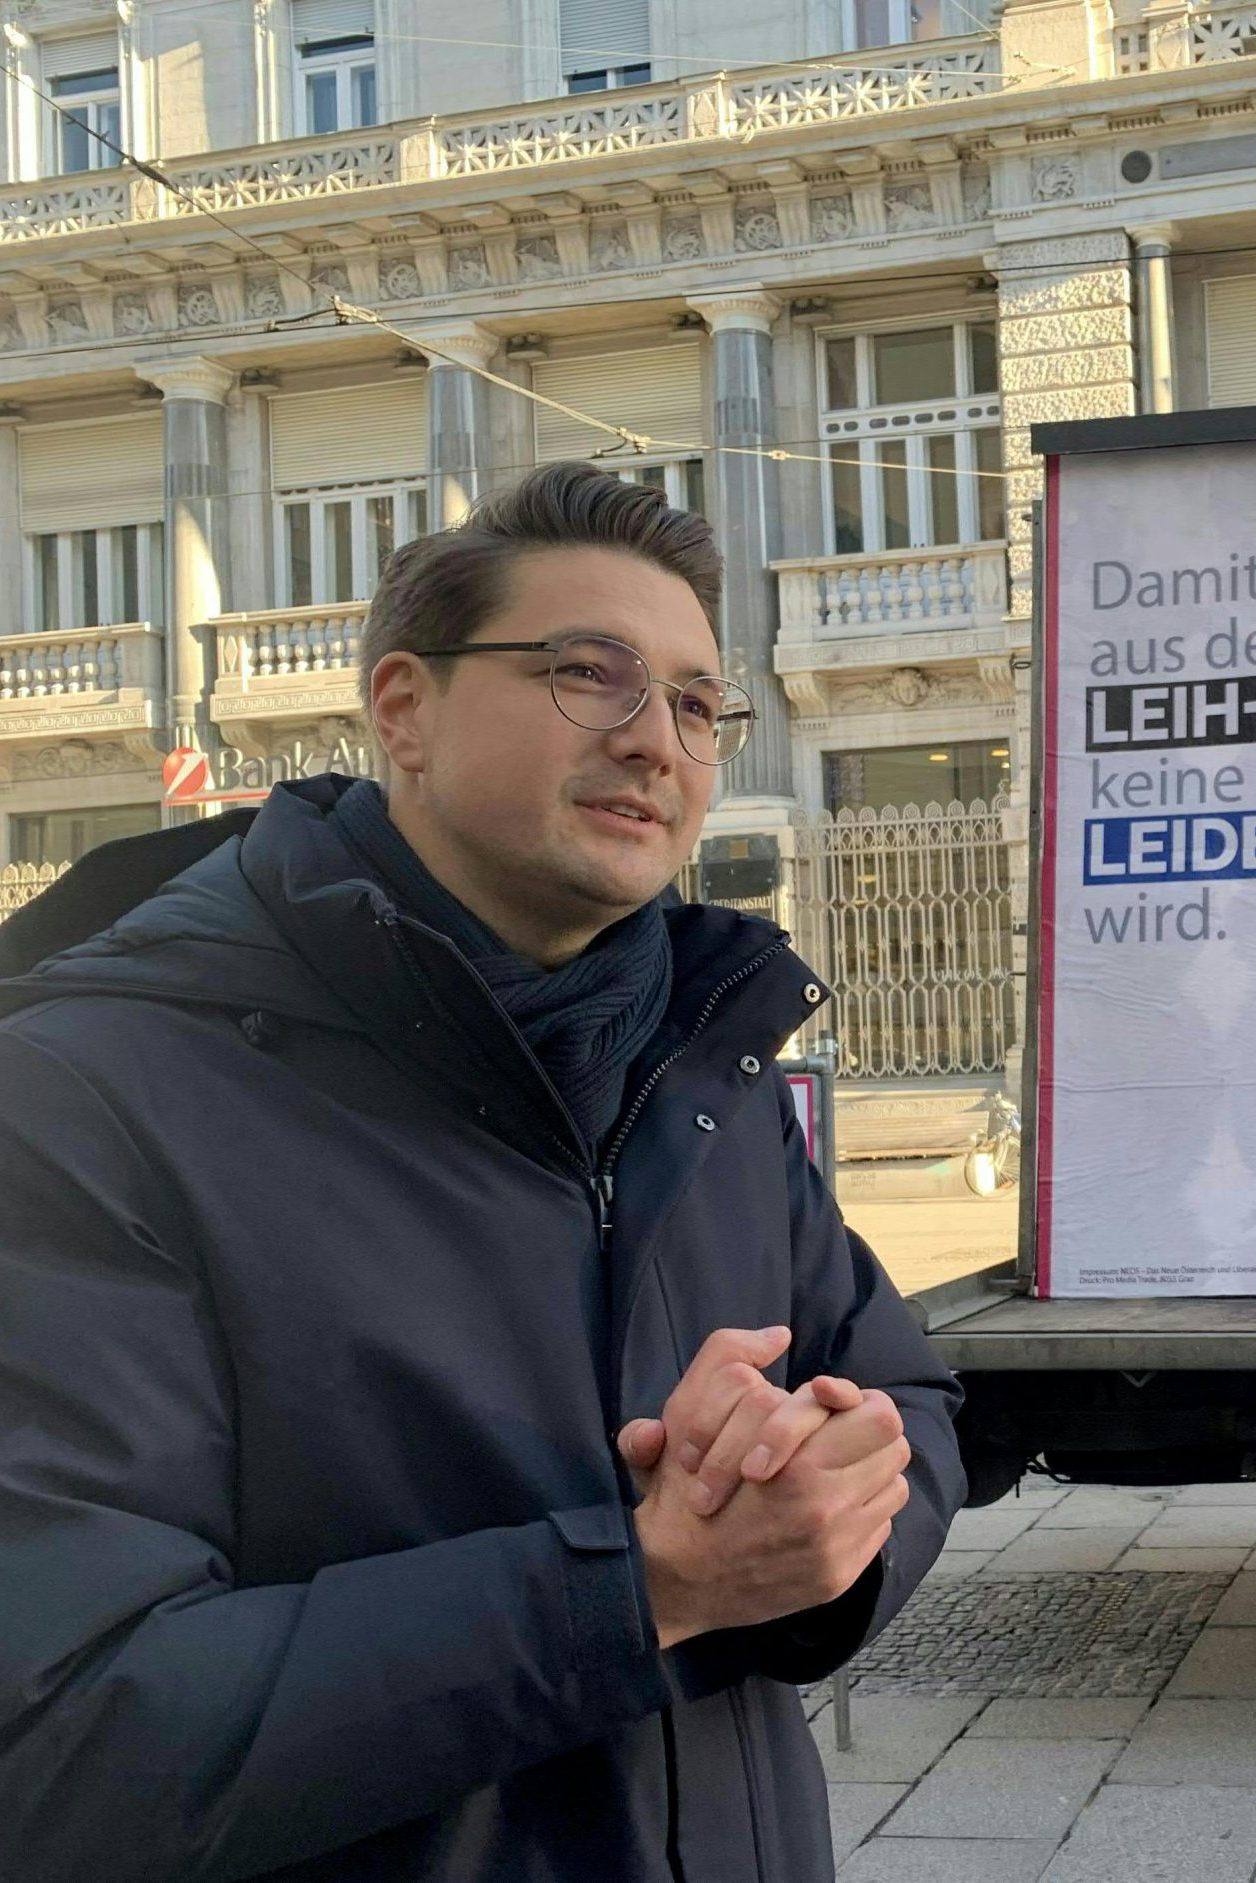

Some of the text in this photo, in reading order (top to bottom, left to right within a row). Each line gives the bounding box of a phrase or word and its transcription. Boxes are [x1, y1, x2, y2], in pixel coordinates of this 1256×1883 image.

[1090, 635, 1186, 677] aus
[214, 741, 315, 791] Bank
[1090, 757, 1245, 809] keine
[1083, 887, 1227, 944] wird.
